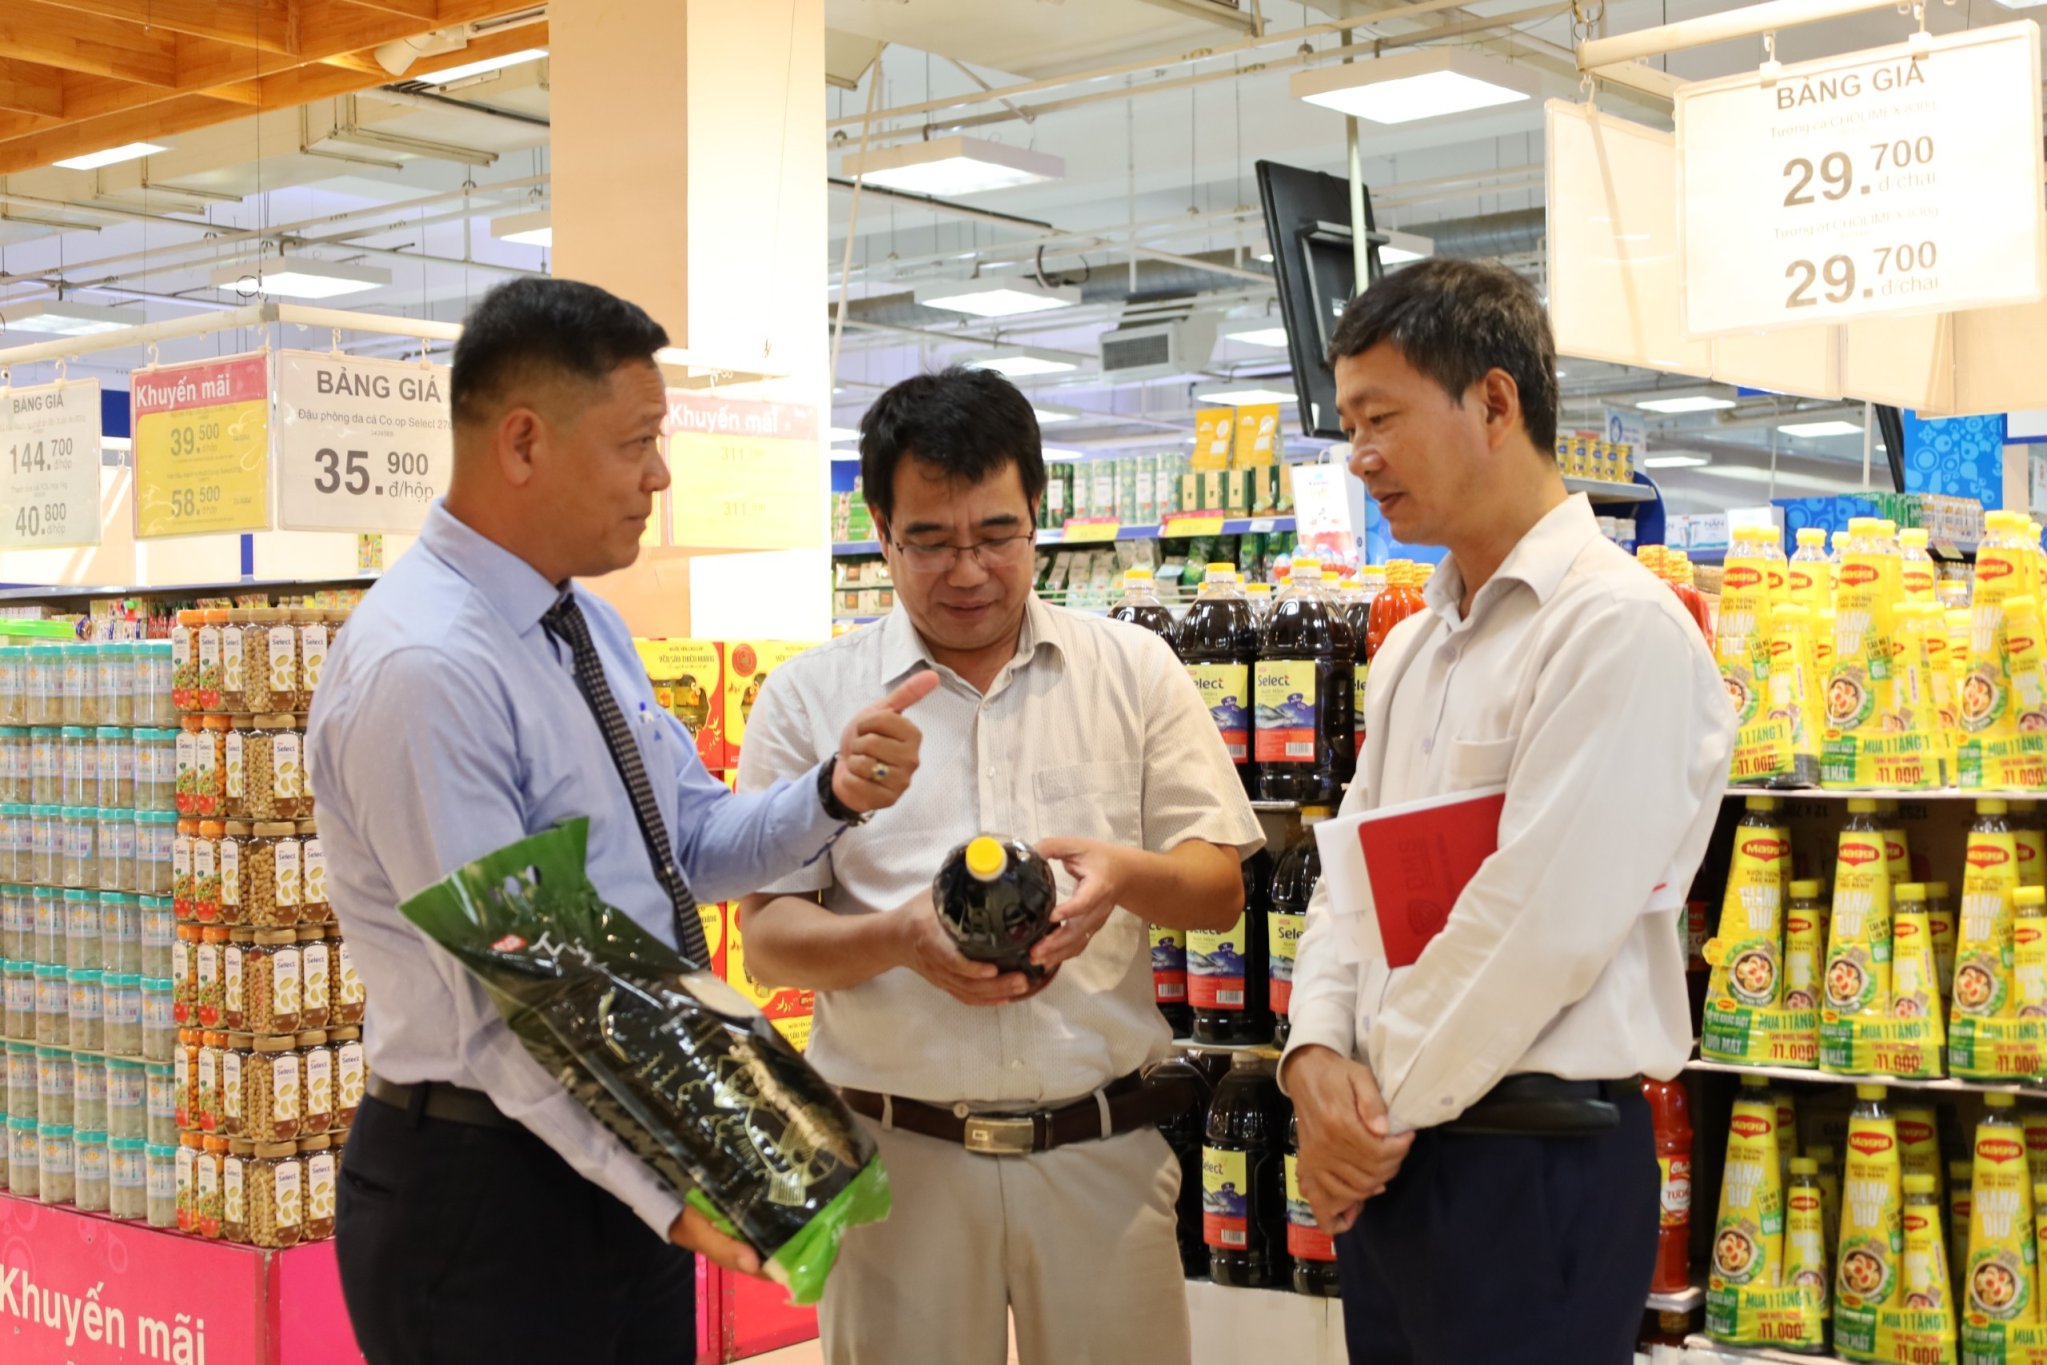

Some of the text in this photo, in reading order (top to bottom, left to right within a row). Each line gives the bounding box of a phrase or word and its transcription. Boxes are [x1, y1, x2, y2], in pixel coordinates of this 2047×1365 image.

[1777, 56, 1926, 110] BẢNG GIÁ
[136, 373, 231, 409] Khuyến mãi
[315, 366, 442, 404] BẢNG GIÁ
[13, 393, 65, 415] BẢNG GIÁ
[408, 417, 436, 429] Select
[669, 404, 779, 433] Khuyến mãi
[388, 480, 435, 504] đ/hộp
[271, 638, 291, 647] Select
[305, 638, 324, 647] Select
[1193, 677, 1224, 690] elect
[1257, 673, 1291, 687] Select
[276, 745, 295, 753] Select
[1278, 926, 1304, 940] Sele
[306, 956, 325, 964] Select
[1850, 1136, 1890, 1148] Maggi
[1979, 1144, 2020, 1156] Maggi
[1202, 1162, 1224, 1176] elect
[278, 1173, 297, 1181] Select
[0, 1263, 206, 1365] Khuyến mãi
